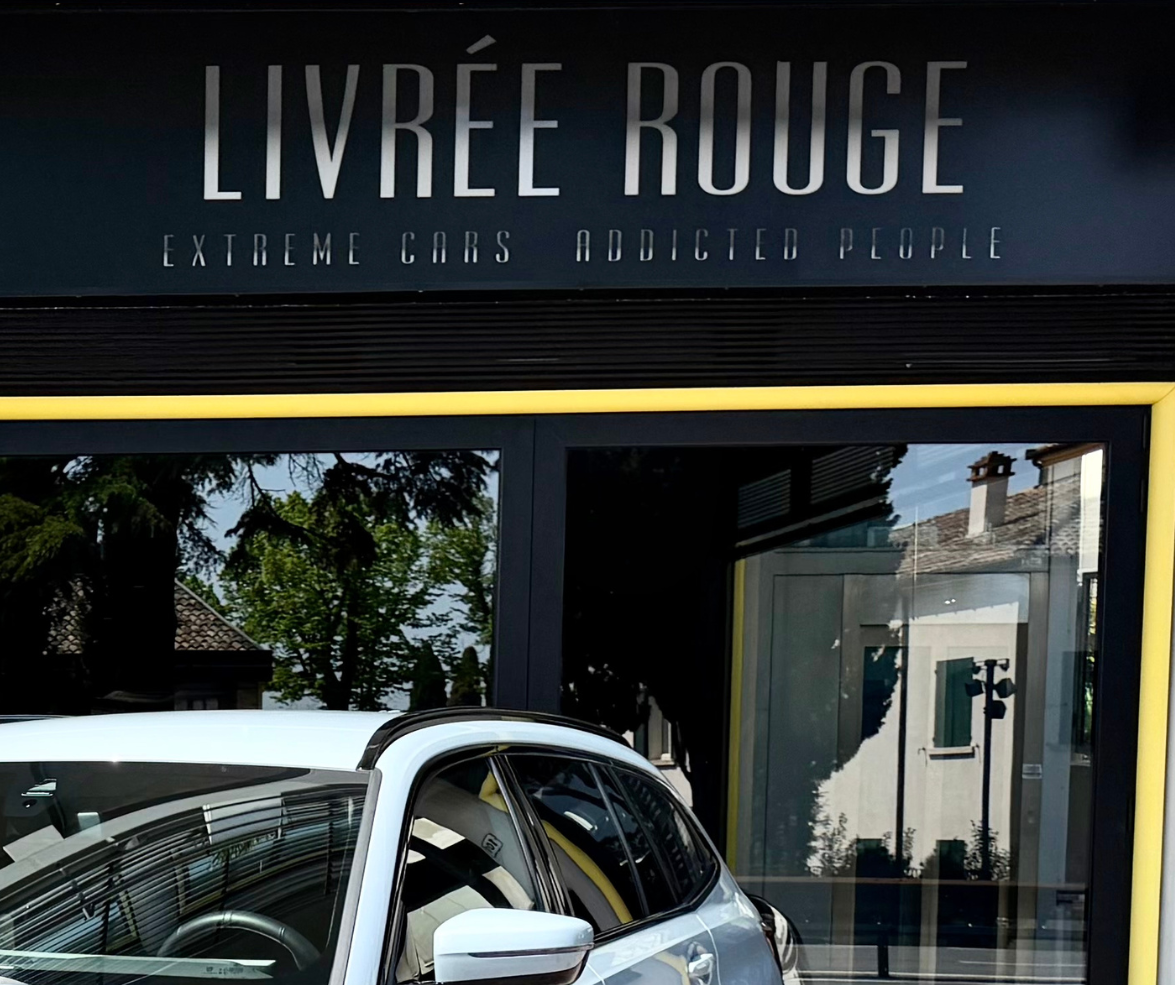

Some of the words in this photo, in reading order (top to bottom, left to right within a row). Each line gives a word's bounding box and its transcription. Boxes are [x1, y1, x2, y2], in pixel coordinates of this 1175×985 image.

[203, 34, 563, 201] LIVRÉE
[625, 60, 969, 197] ROUGE
[162, 230, 362, 268] EXTREME
[400, 230, 512, 266] CARS
[576, 227, 800, 263] ADDICTED
[839, 226, 1005, 261] PEOPLE
